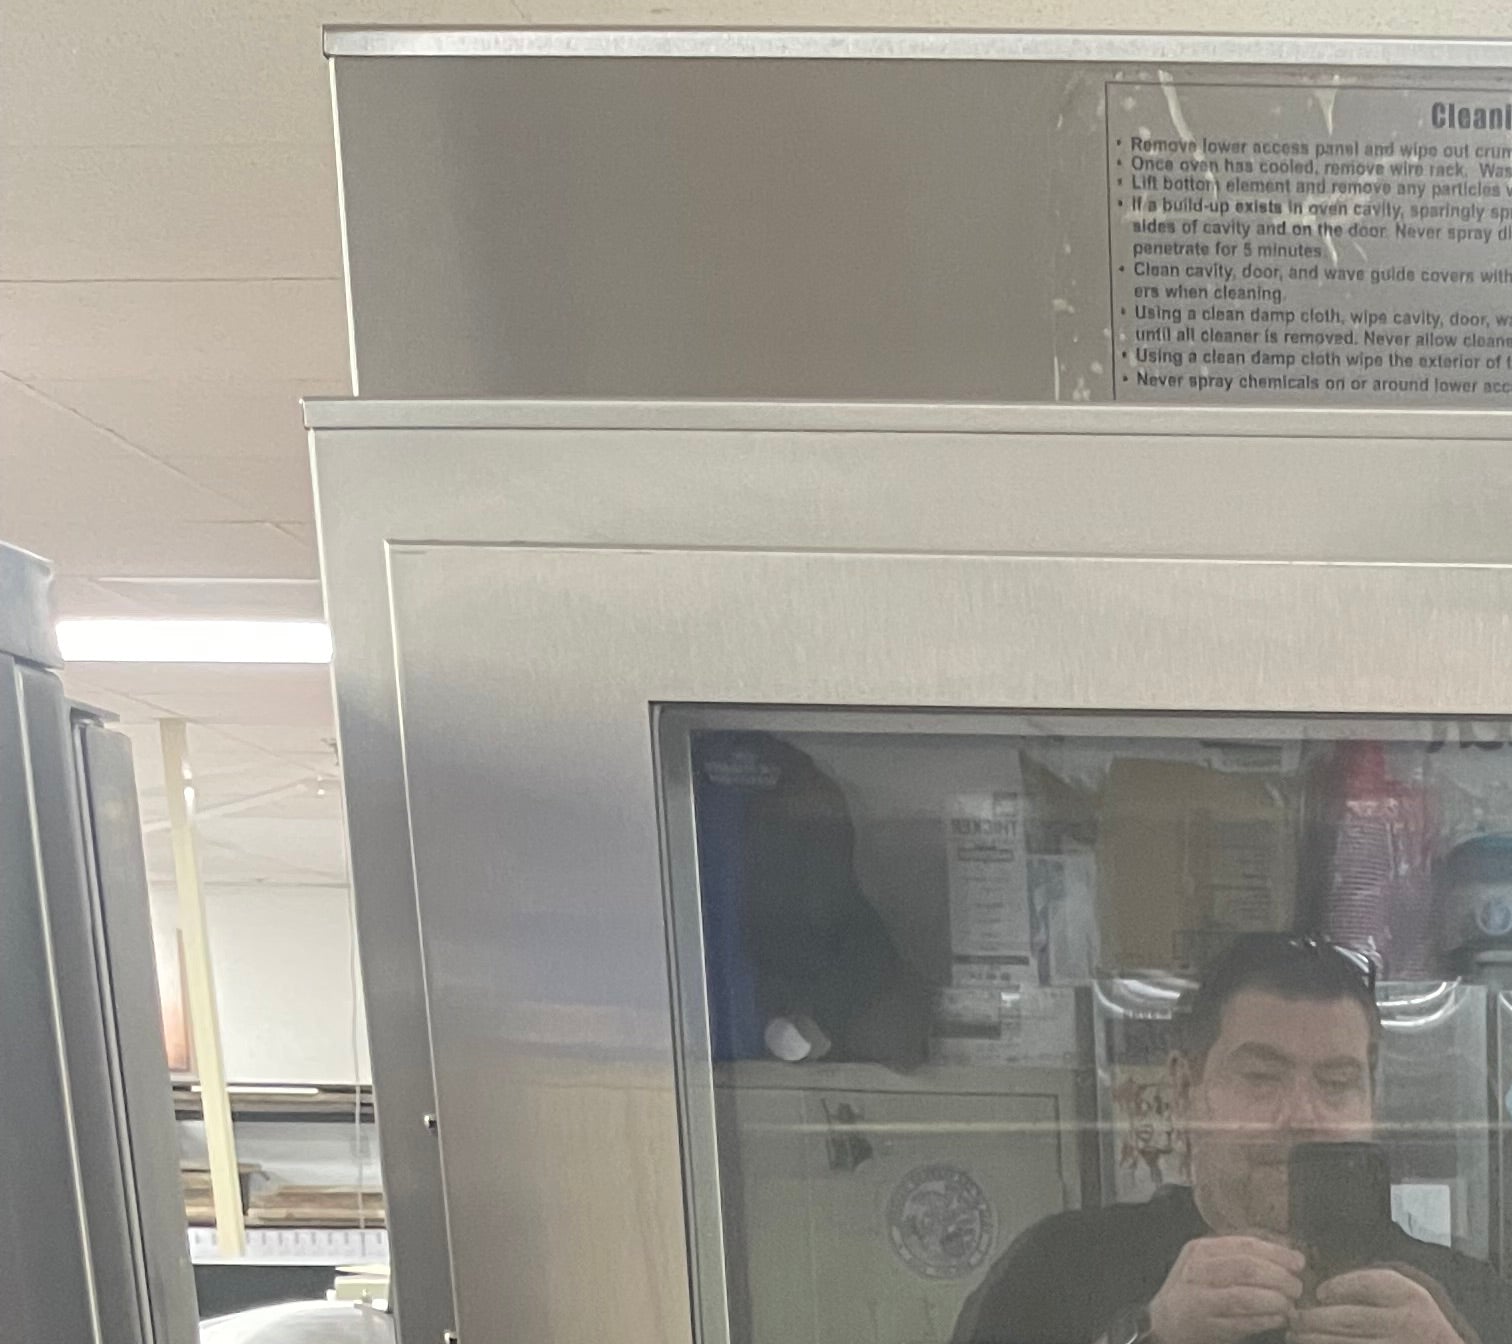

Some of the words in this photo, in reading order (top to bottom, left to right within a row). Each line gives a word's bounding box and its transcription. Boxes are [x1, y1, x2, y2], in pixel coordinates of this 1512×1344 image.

[1202, 138, 1248, 152] lower
[1252, 143, 1309, 154] access
[1315, 142, 1359, 157] panel
[1364, 142, 1395, 156] and
[1399, 144, 1438, 159] wipe
[1442, 145, 1469, 157] out
[1131, 197, 1143, 210] If
[1147, 201, 1158, 211] a
[1162, 198, 1230, 213] build-up
[1234, 201, 1283, 213] exists
[1287, 201, 1304, 214] in
[1308, 205, 1348, 215] oven
[1410, 204, 1485, 221] sparingly
[1132, 243, 1210, 256] penetrate
[1215, 242, 1238, 256] for
[1243, 243, 1253, 256] 5
[1133, 262, 1180, 276] Clean
[1288, 265, 1319, 279] and
[1323, 269, 1365, 280] wave
[1370, 267, 1415, 283] guide
[1420, 271, 1475, 282] covers
[1133, 287, 1160, 297] ers
[1165, 285, 1209, 298] when
[1134, 306, 1182, 323] Using
[1187, 309, 1197, 320] a
[1201, 307, 1245, 320] clean
[1250, 309, 1296, 323] damp
[1350, 312, 1388, 326] wipe
[1135, 328, 1172, 341] until
[1176, 328, 1195, 341] all
[1200, 330, 1259, 342] cleaner
[1264, 329, 1278, 343] is
[1363, 331, 1411, 345] Never
[1415, 333, 1458, 346] allow
[1135, 348, 1183, 366] Using
[1188, 352, 1198, 362] a
[1202, 350, 1246, 363] clean
[1250, 351, 1296, 366] damp
[1300, 352, 1341, 365] cloth
[1345, 356, 1383, 369] wipe
[1388, 354, 1414, 366] the
[1418, 356, 1481, 368] exterior
[1485, 355, 1502, 368] of
[1136, 372, 1184, 386] Never
[1188, 376, 1234, 391] spray
[1238, 375, 1320, 388] chemicals
[1324, 379, 1346, 390] on
[1350, 380, 1368, 390] or
[1372, 379, 1430, 391] around
[1434, 379, 1478, 392] lower
